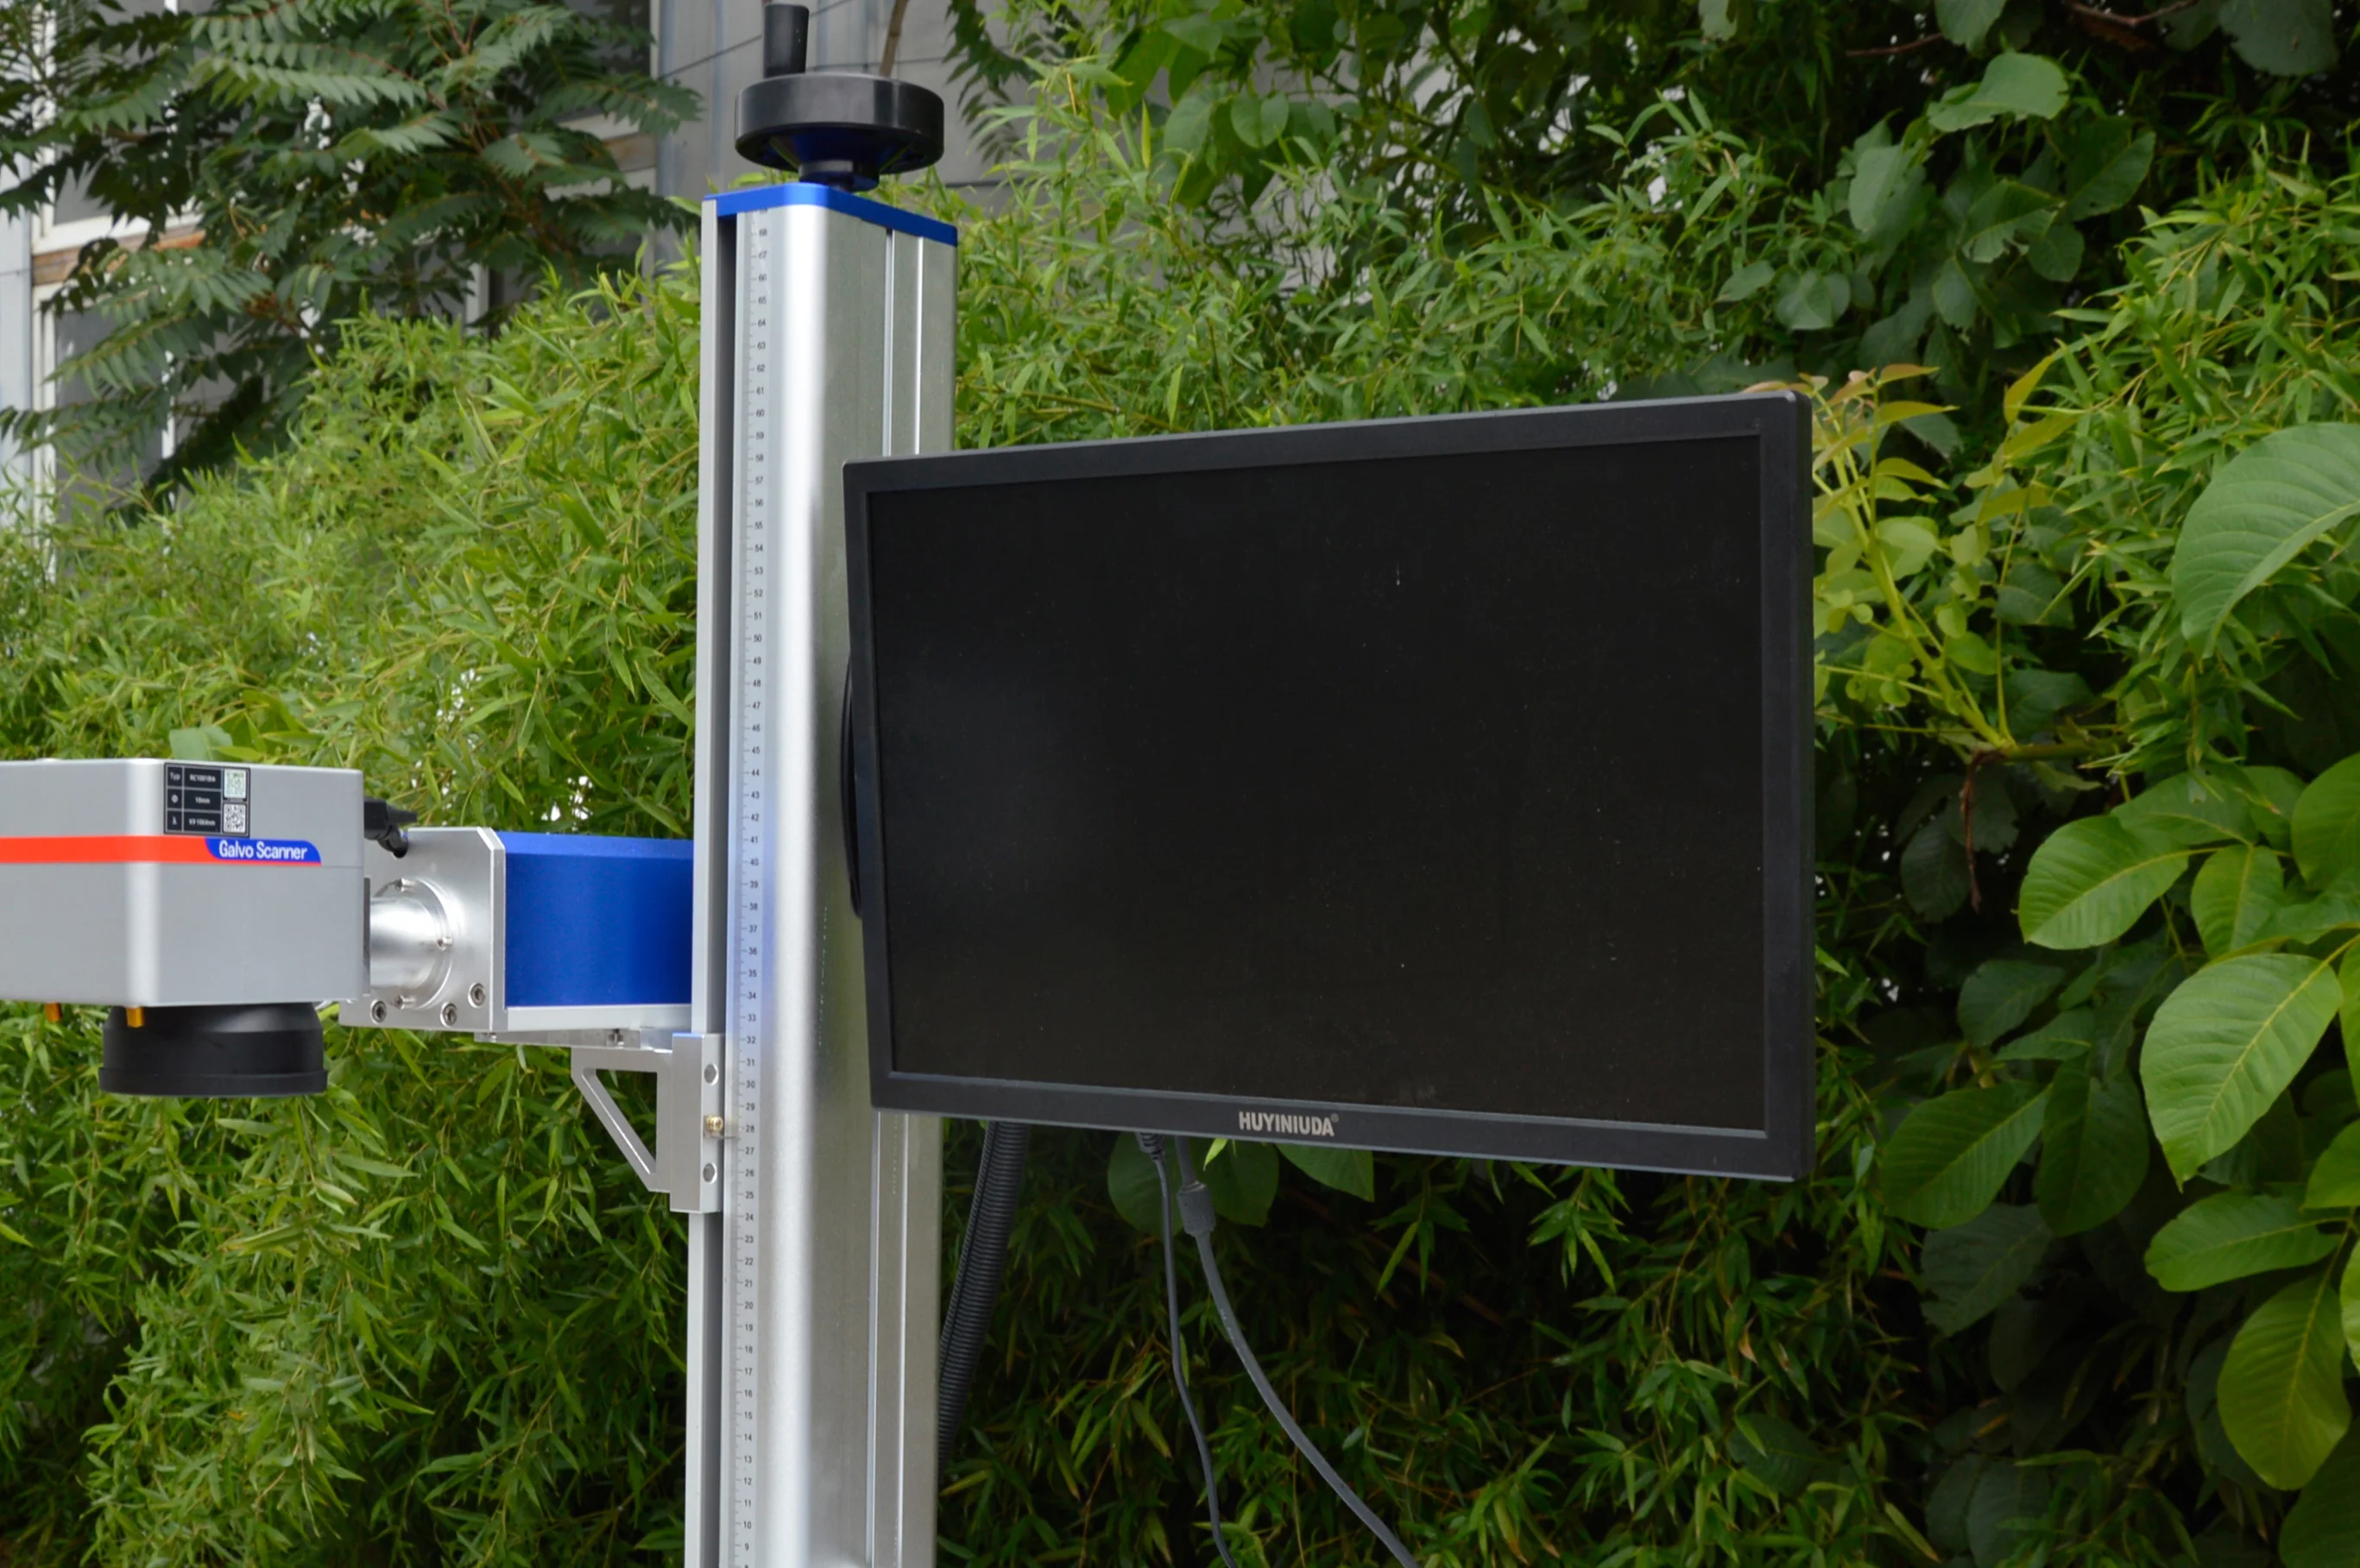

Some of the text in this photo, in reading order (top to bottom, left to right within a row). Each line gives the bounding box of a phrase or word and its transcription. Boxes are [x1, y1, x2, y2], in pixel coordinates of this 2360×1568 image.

[759, 274, 767, 282] 66
[758, 296, 767, 305] 65
[757, 319, 766, 328] 64
[757, 342, 766, 350] 63
[757, 364, 766, 373] 62
[756, 387, 765, 395] 61
[756, 409, 765, 418] 60
[756, 431, 765, 440] 59
[755, 454, 764, 463] 58
[755, 475, 764, 485] 57
[755, 499, 764, 507] 56
[754, 521, 763, 530] 55
[755, 545, 764, 553] 54
[754, 566, 763, 575] 53
[754, 589, 763, 597] 52
[754, 612, 762, 620] 51
[754, 634, 762, 643] 50
[753, 657, 761, 665] 49
[753, 679, 761, 688] 48
[753, 702, 761, 710] 47
[752, 724, 760, 733] 46
[752, 746, 760, 755] 45
[170, 771, 180, 781] Typ
[751, 790, 760, 799] 43
[751, 813, 760, 822] 42
[218, 840, 308, 861] Galvo Scanner
[750, 858, 759, 866] 40
[749, 880, 759, 889] 39
[749, 903, 758, 911] 38
[749, 925, 758, 934] 37
[748, 947, 757, 955] 36
[748, 969, 757, 978] 35
[748, 992, 756, 1000] 34
[748, 1014, 756, 1023] 33
[747, 1036, 756, 1044] 32
[747, 1058, 755, 1067] 31
[747, 1080, 755, 1088] 30
[746, 1102, 755, 1111] 29
[746, 1124, 754, 1133] 28
[1239, 1111, 1335, 1137] HUYINIUDA
[746, 1147, 754, 1156] 27
[746, 1168, 754, 1177] 26
[746, 1191, 754, 1200] 25
[746, 1212, 754, 1221] 24
[745, 1235, 754, 1244] 23
[745, 1256, 754, 1266] 22
[744, 1279, 753, 1288] 21
[745, 1301, 754, 1310] 20
[745, 1324, 754, 1332] 19
[745, 1345, 754, 1354] 18
[745, 1368, 754, 1376] 17
[745, 1389, 754, 1398] 16
[745, 1412, 754, 1420] 15
[744, 1455, 753, 1464] 13
[744, 1477, 753, 1486] 12
[745, 1499, 752, 1508] 11
[743, 1521, 752, 1529] 10
